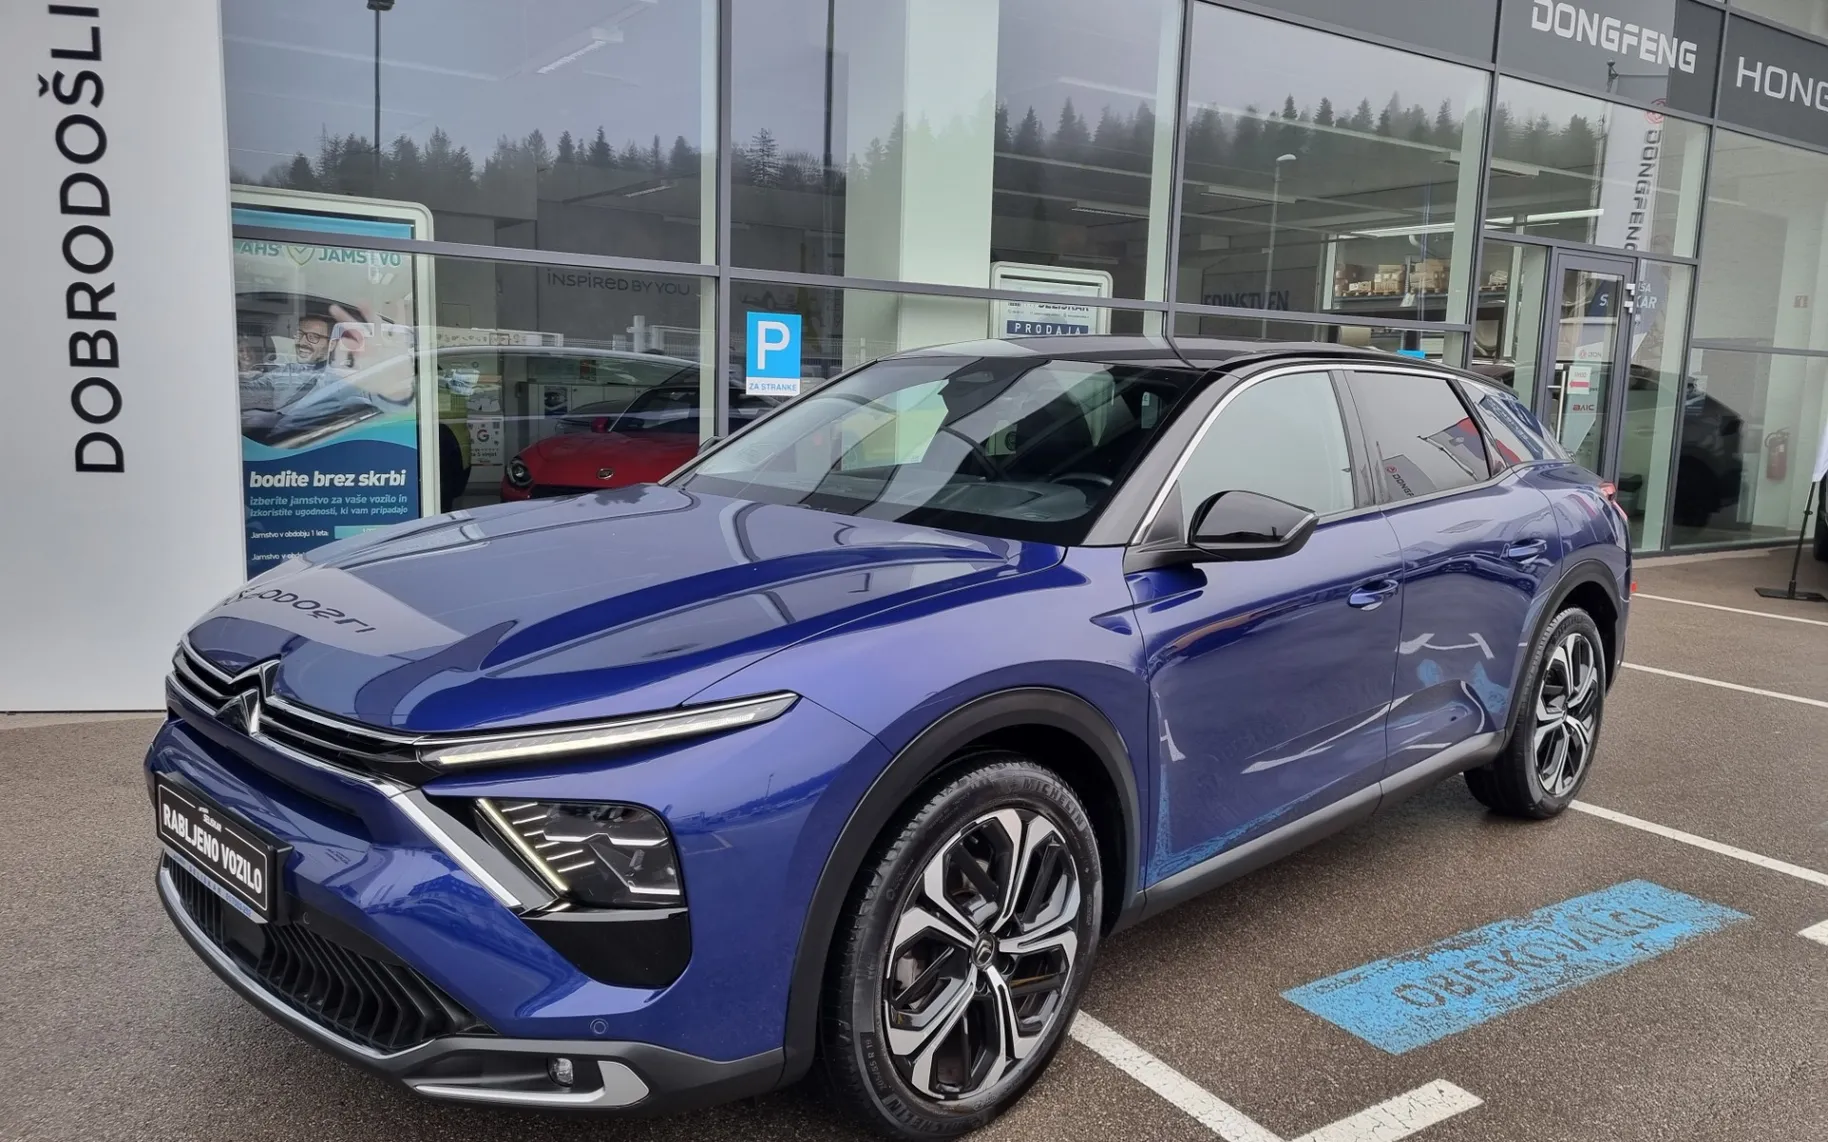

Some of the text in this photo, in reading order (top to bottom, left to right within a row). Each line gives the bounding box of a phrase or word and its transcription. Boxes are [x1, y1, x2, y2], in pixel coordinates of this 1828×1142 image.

[1531, 0, 1698, 74] DONGFENG
[37, 4, 125, 473] DOBRODOŠLI
[632, 279, 653, 292] BY
[654, 281, 690, 295] YOU
[757, 320, 790, 370] P
[761, 383, 797, 391] STRANKE
[250, 469, 407, 488] bodite brez skrbi
[289, 495, 329, 507] jamstvo
[331, 496, 342, 504] za
[345, 494, 367, 504] vaše
[369, 494, 396, 504] vozilo
[398, 494, 408, 503] in
[340, 507, 349, 515] ki
[351, 507, 369, 515] vam
[370, 506, 408, 517] pripadajo
[251, 530, 279, 539] Jamstvo
[285, 530, 310, 539] obdobju
[251, 552, 280, 561] Jamstvo
[163, 803, 263, 894] RABLJENO VOZILO
